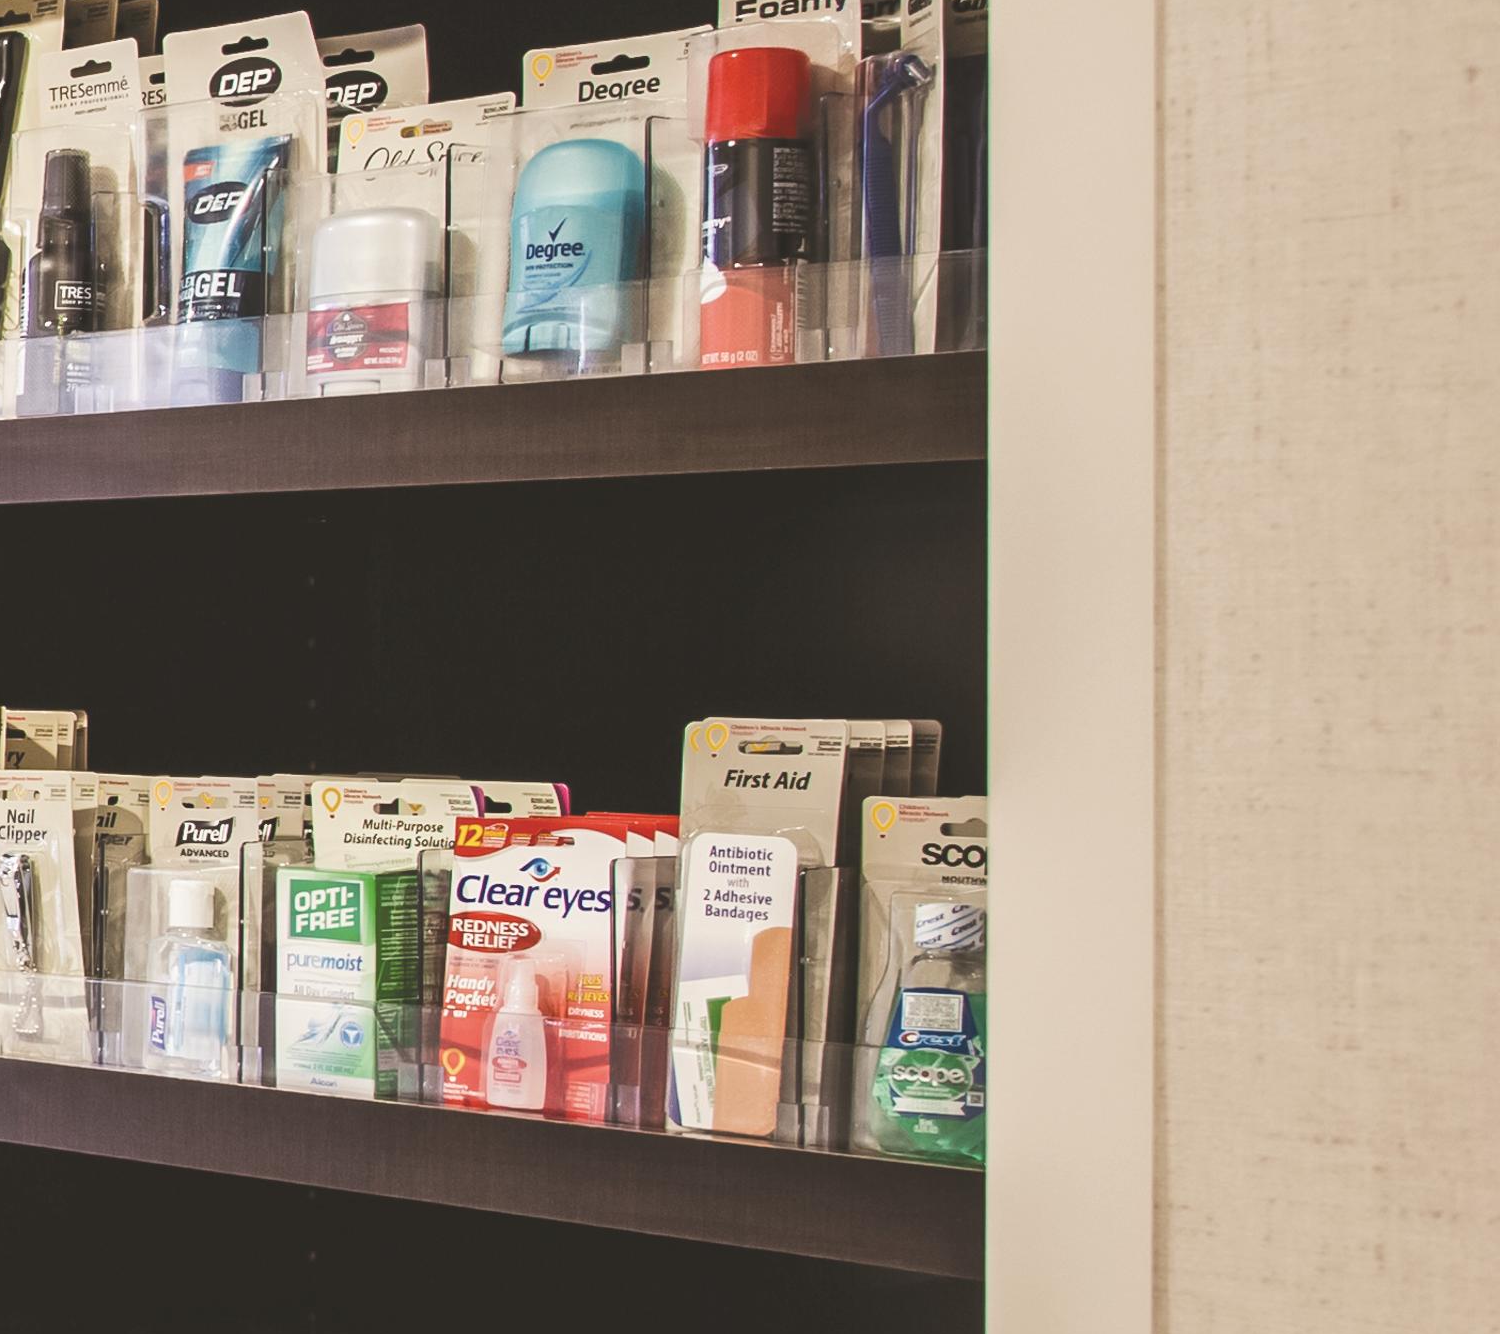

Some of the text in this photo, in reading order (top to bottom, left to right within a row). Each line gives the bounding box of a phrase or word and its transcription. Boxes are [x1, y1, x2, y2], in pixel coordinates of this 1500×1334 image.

[49, 74, 130, 103] TRESemmé
[219, 68, 277, 96] DEP
[578, 76, 661, 103] Degree
[326, 81, 382, 106] DEP
[237, 110, 268, 131] GEL
[194, 191, 243, 216] DEP
[525, 238, 583, 262] Degree
[59, 285, 92, 301] TRES
[195, 271, 241, 299] GEL
[724, 769, 812, 791] First Aid
[6, 809, 35, 825] Nail
[362, 819, 444, 833] Multi-Purpose
[181, 819, 232, 843] Purell
[179, 847, 229, 859] ADVANCED
[709, 845, 773, 861] Antibiotic
[709, 861, 771, 876] Ointment
[293, 885, 354, 912] OPTI-
[456, 875, 612, 918] Clear eyes
[703, 889, 772, 905] 2 Adhesive
[295, 907, 356, 931] FREE
[704, 904, 768, 922] Bandages
[916, 913, 945, 928] Crest
[452, 917, 529, 937] REDNESS
[462, 933, 518, 950] RELIEF
[286, 952, 363, 972] puremoist
[447, 974, 495, 994] Handy
[446, 989, 497, 1007] Pocket
[151, 999, 166, 1047] Purell
[900, 1031, 966, 1046] Crest
